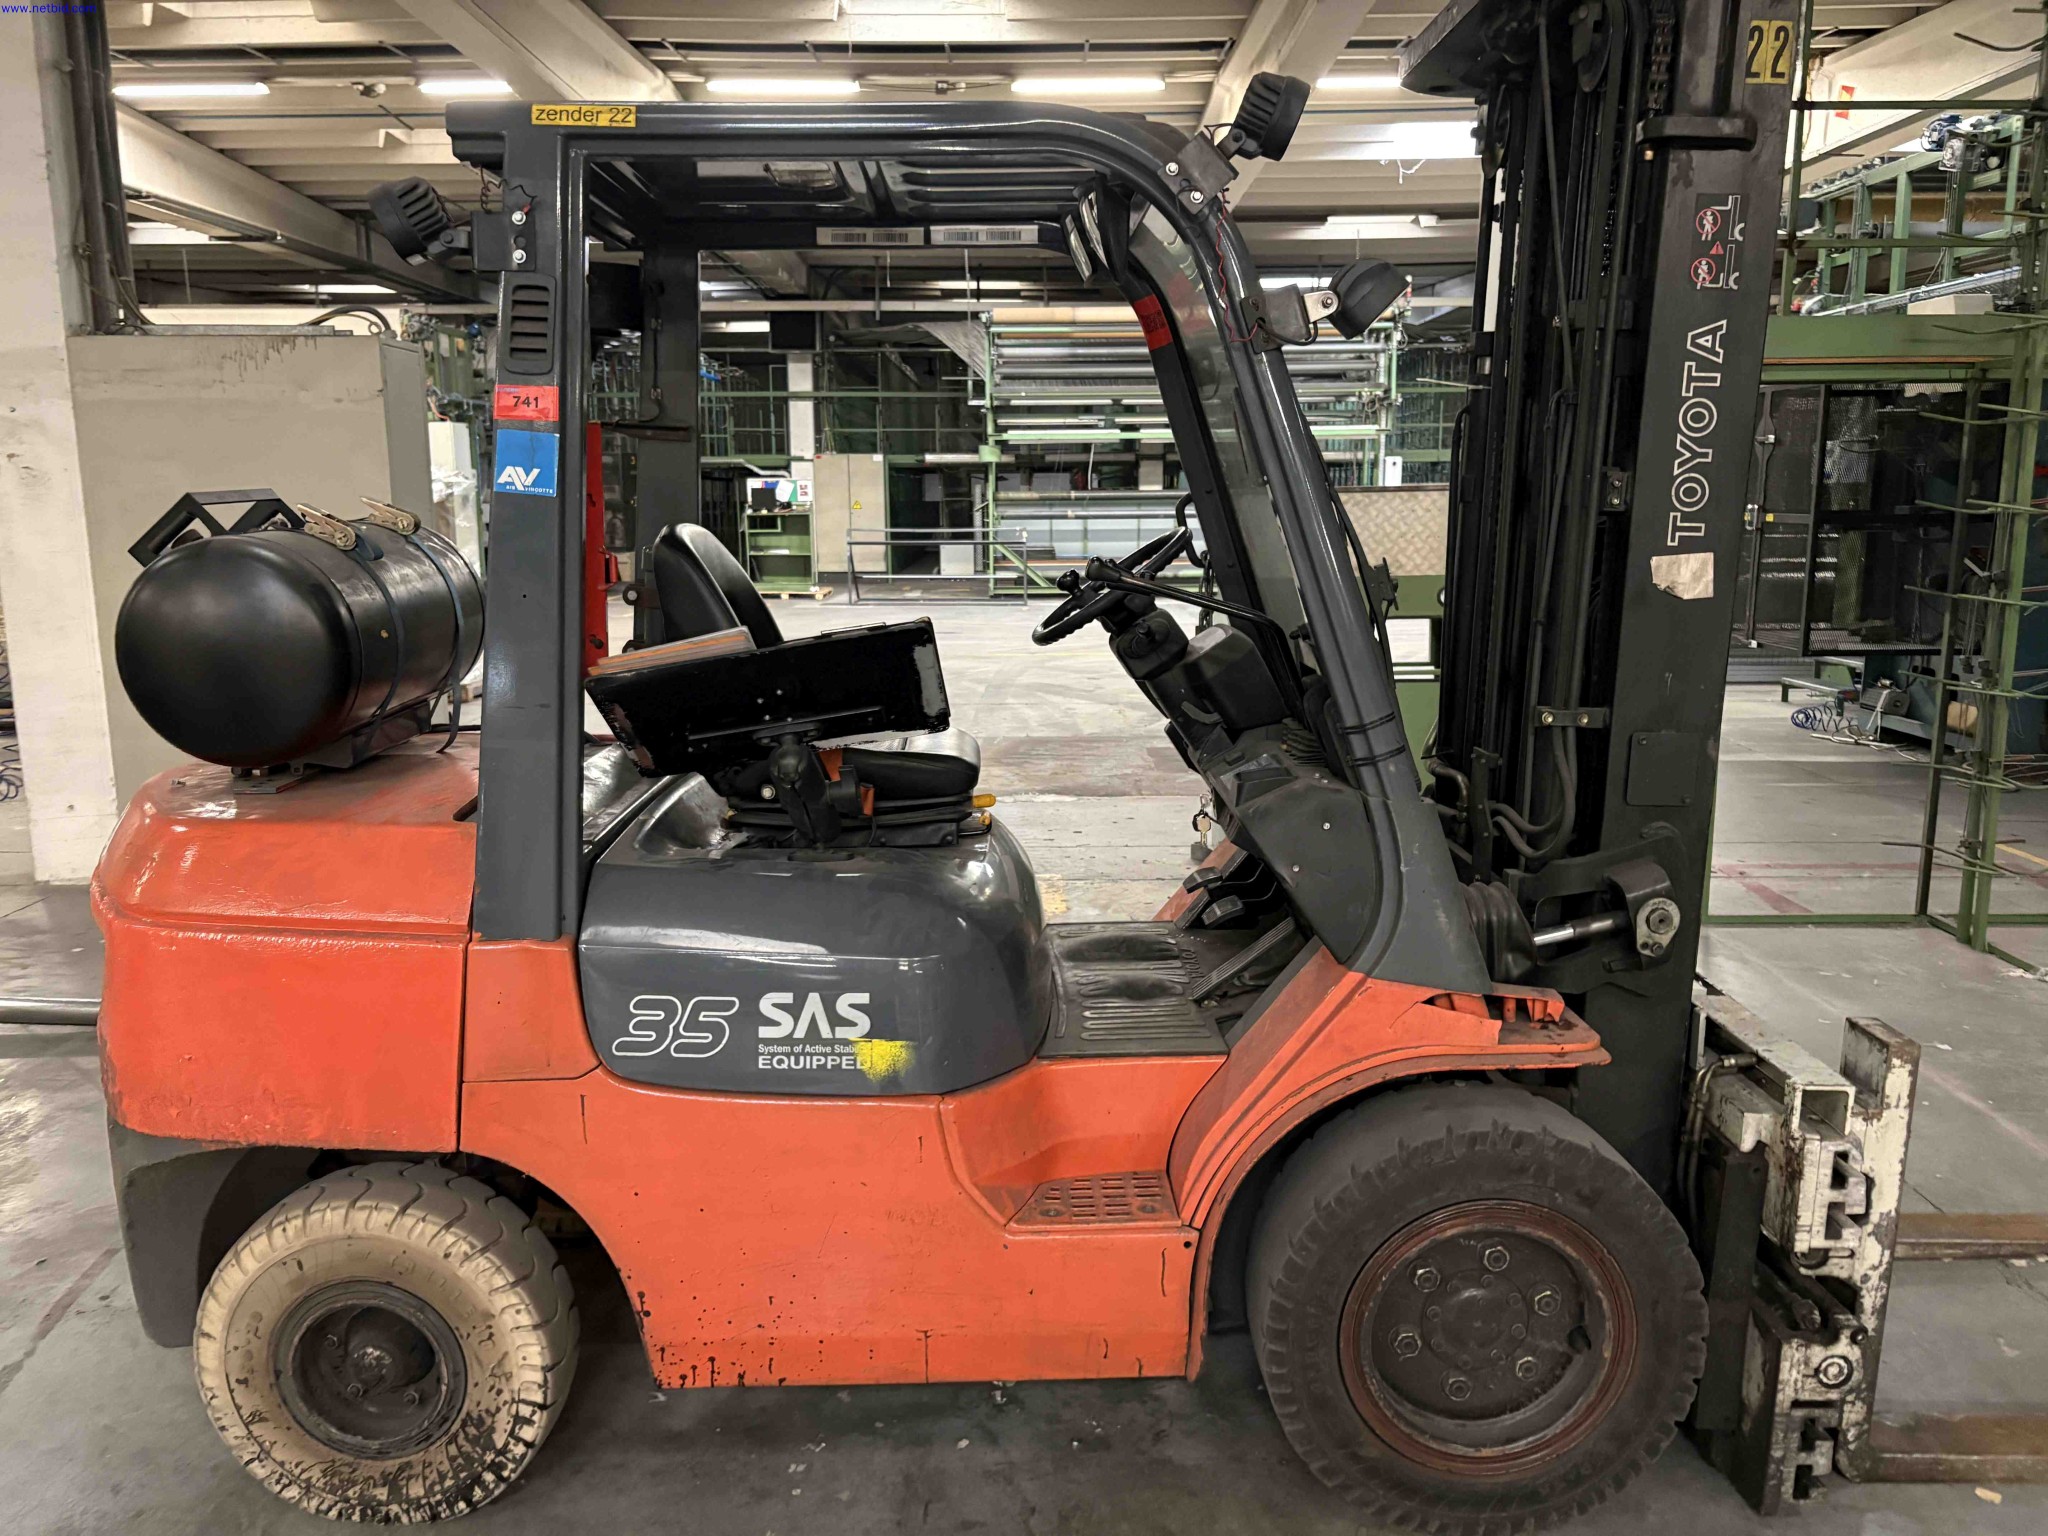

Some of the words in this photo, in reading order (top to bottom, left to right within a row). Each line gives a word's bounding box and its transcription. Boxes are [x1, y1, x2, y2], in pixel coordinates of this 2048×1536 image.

[1745, 25, 1790, 79] 22
[535, 106, 602, 122] zender
[608, 107, 632, 123] 22
[512, 395, 539, 409] 741
[1667, 319, 1727, 546] TOYOTA
[612, 995, 739, 1058] 35
[758, 992, 871, 1039] SAS
[758, 1043, 791, 1054] System
[793, 1044, 803, 1053] of
[805, 1044, 831, 1053] Active
